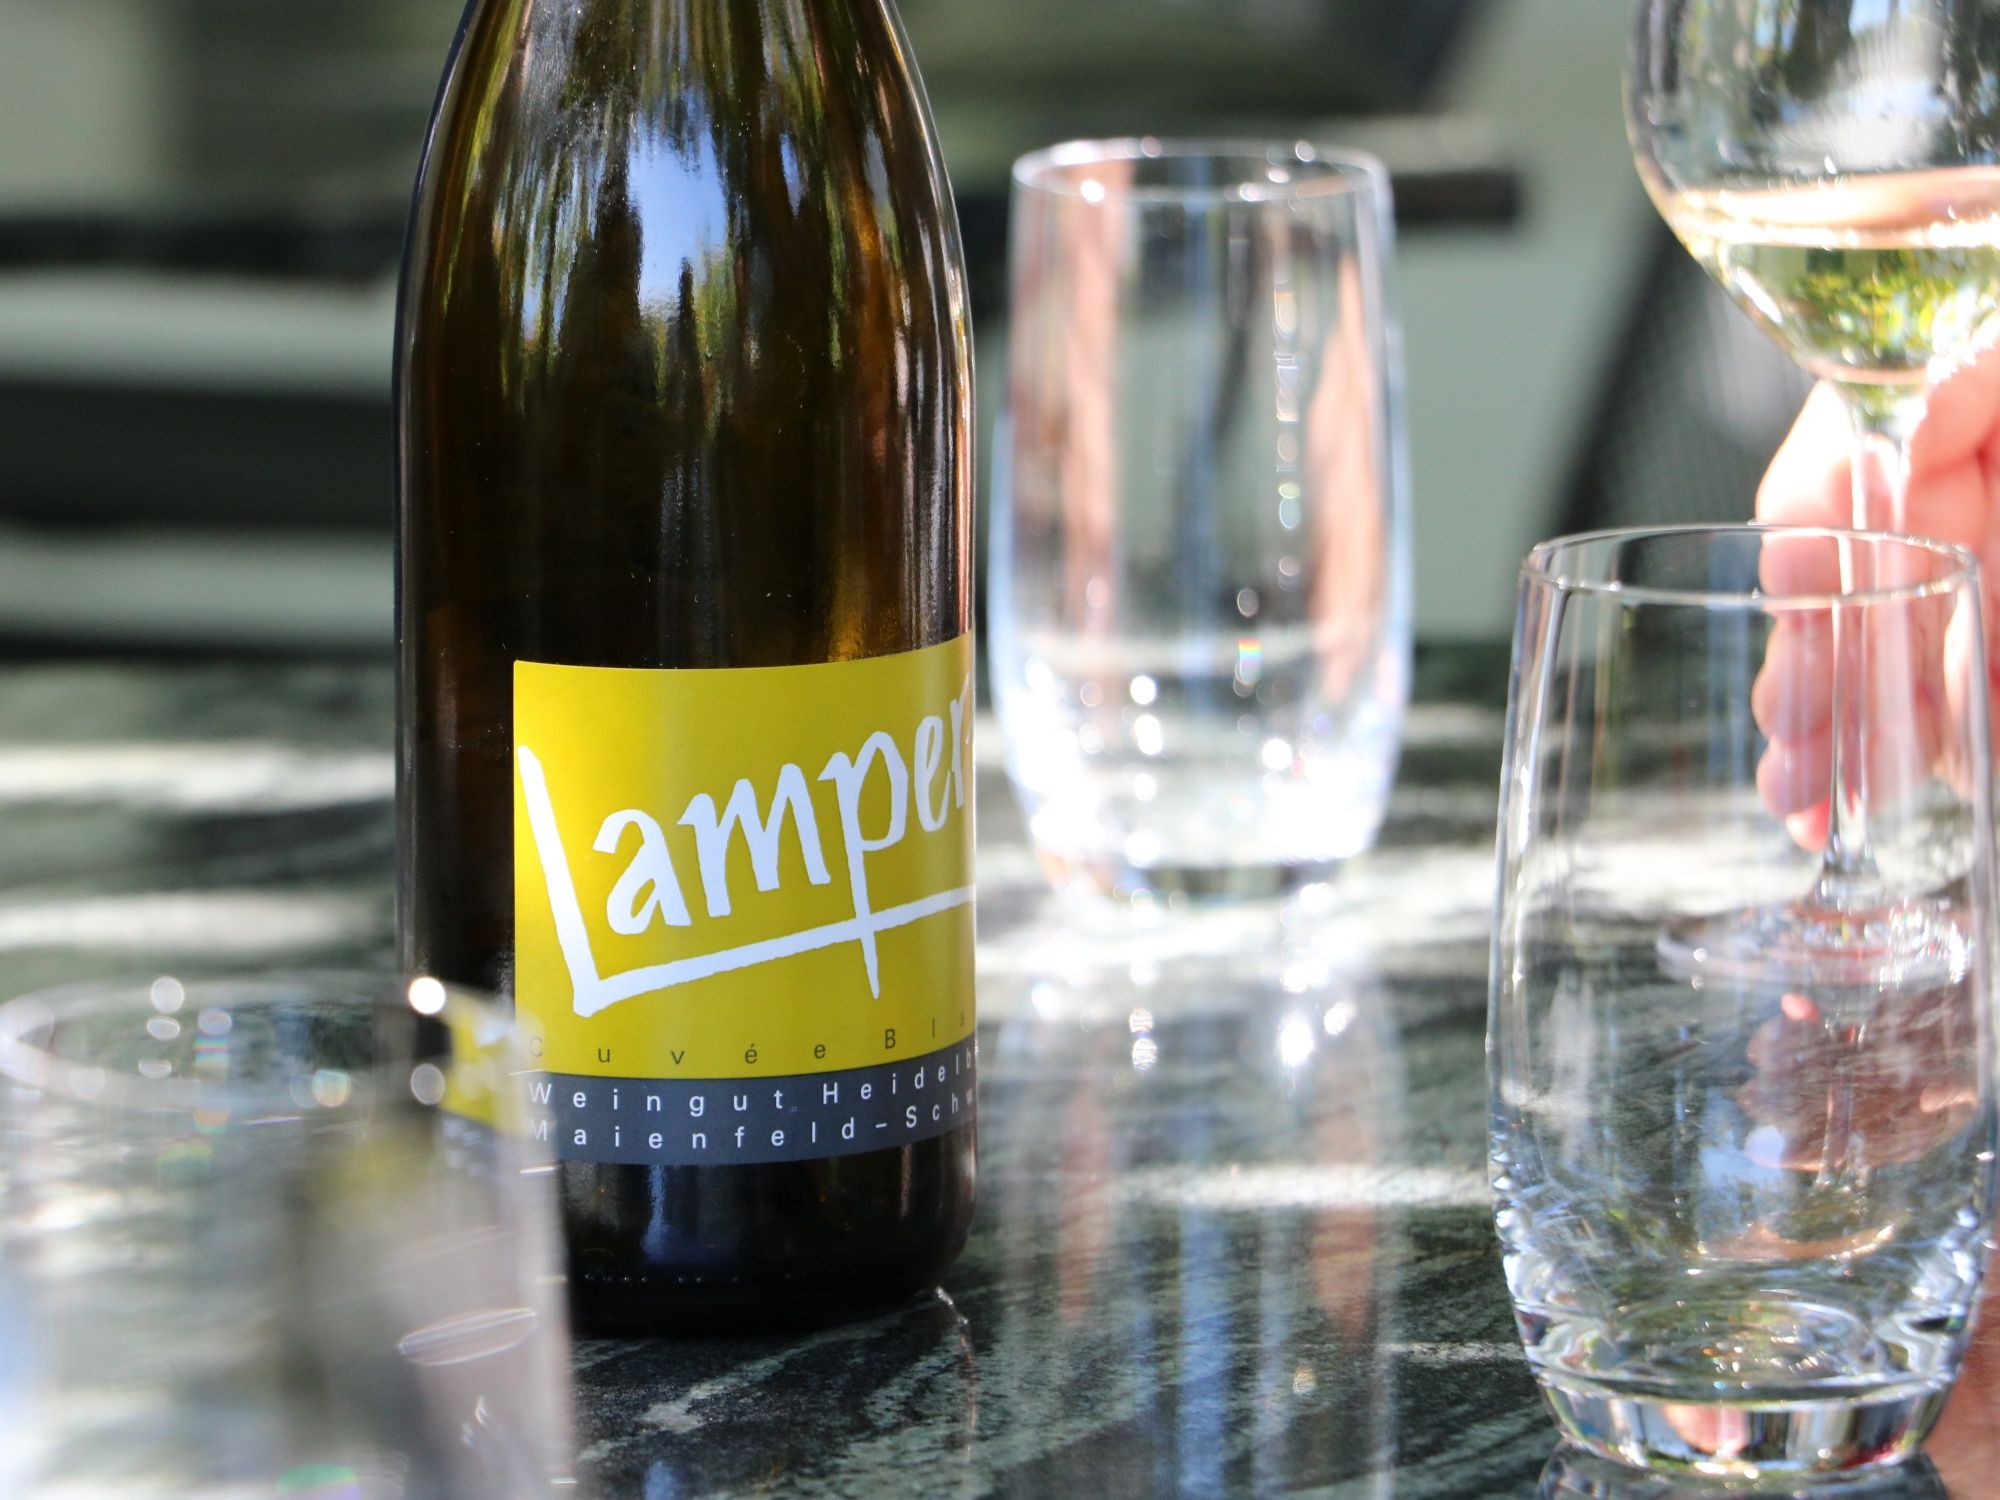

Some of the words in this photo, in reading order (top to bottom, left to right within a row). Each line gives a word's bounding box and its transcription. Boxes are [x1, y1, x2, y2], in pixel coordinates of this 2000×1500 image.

[517, 672, 975, 1017] Lamper
[529, 1035, 827, 1065] Cuvée
[529, 1081, 784, 1117] Weingut
